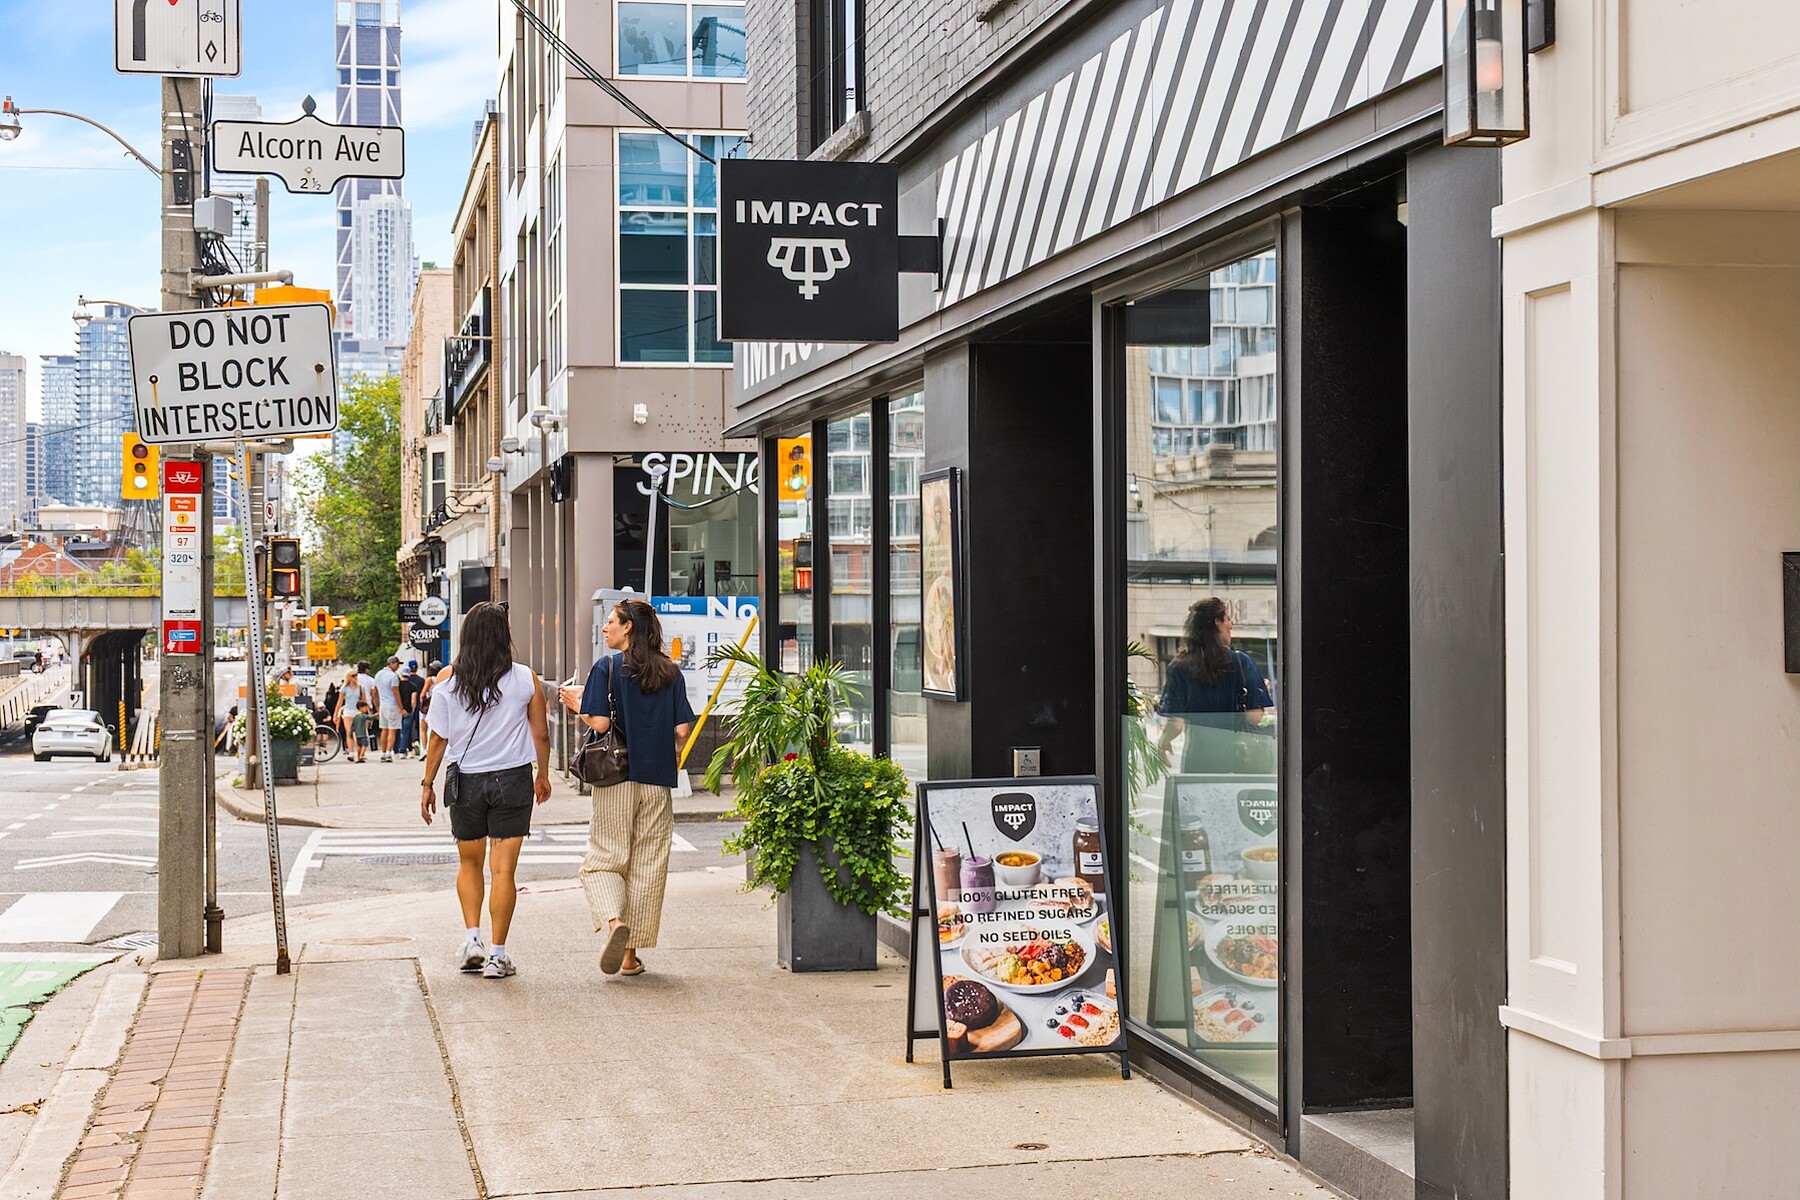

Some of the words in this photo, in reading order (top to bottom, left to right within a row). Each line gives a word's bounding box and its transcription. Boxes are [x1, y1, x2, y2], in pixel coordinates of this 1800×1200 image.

[237, 131, 322, 161] Alcorn
[335, 134, 381, 162] Ave
[299, 177, 309, 190] 2
[735, 200, 883, 227] IMPACT
[168, 317, 215, 350] DO
[226, 313, 291, 347] NOT
[178, 355, 290, 392] BLOCK
[143, 395, 332, 437] INTERSECTION
[176, 537, 189, 547] 97
[170, 553, 188, 564] 320
[994, 803, 1034, 813] IMPACT
[959, 891, 991, 903] 100%
[994, 889, 1048, 902] GLUTEN
[1051, 887, 1085, 899] FREE
[954, 912, 974, 925] NO
[977, 910, 1035, 923] REFINED
[1039, 908, 1092, 920] SUGARS
[979, 932, 999, 943] NO
[1002, 930, 1038, 942] SEED
[1041, 928, 1072, 940] OILS
